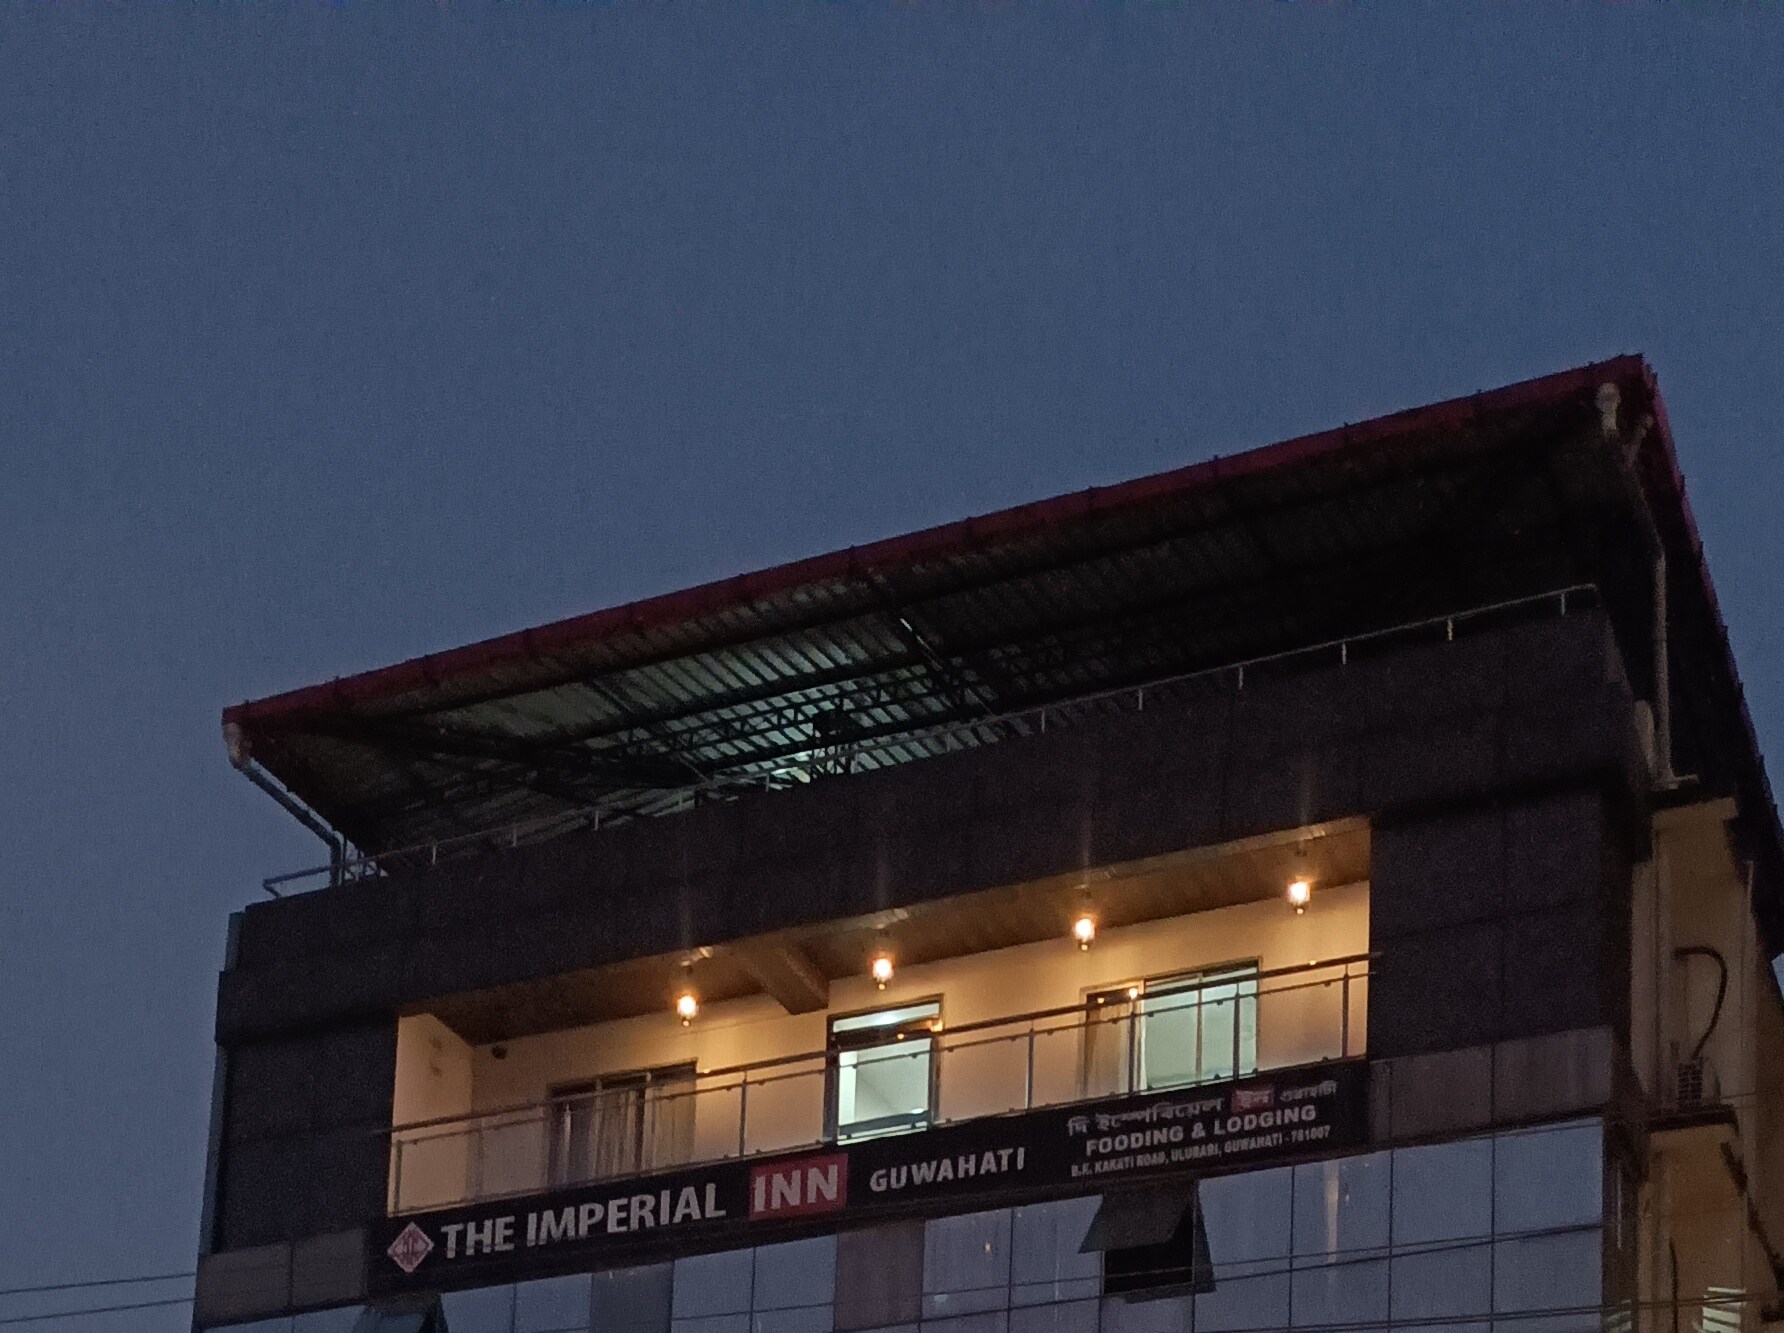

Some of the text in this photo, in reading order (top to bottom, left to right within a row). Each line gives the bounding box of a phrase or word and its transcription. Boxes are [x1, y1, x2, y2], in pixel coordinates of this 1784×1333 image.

[1086, 1104, 1316, 1156] FOODING & LODGING
[1094, 1155, 1134, 1173] KAKATI
[1224, 1132, 1283, 1153] GUWAHATI
[440, 1147, 1025, 1259] THE IMPERIAL INN GUWAHATI
